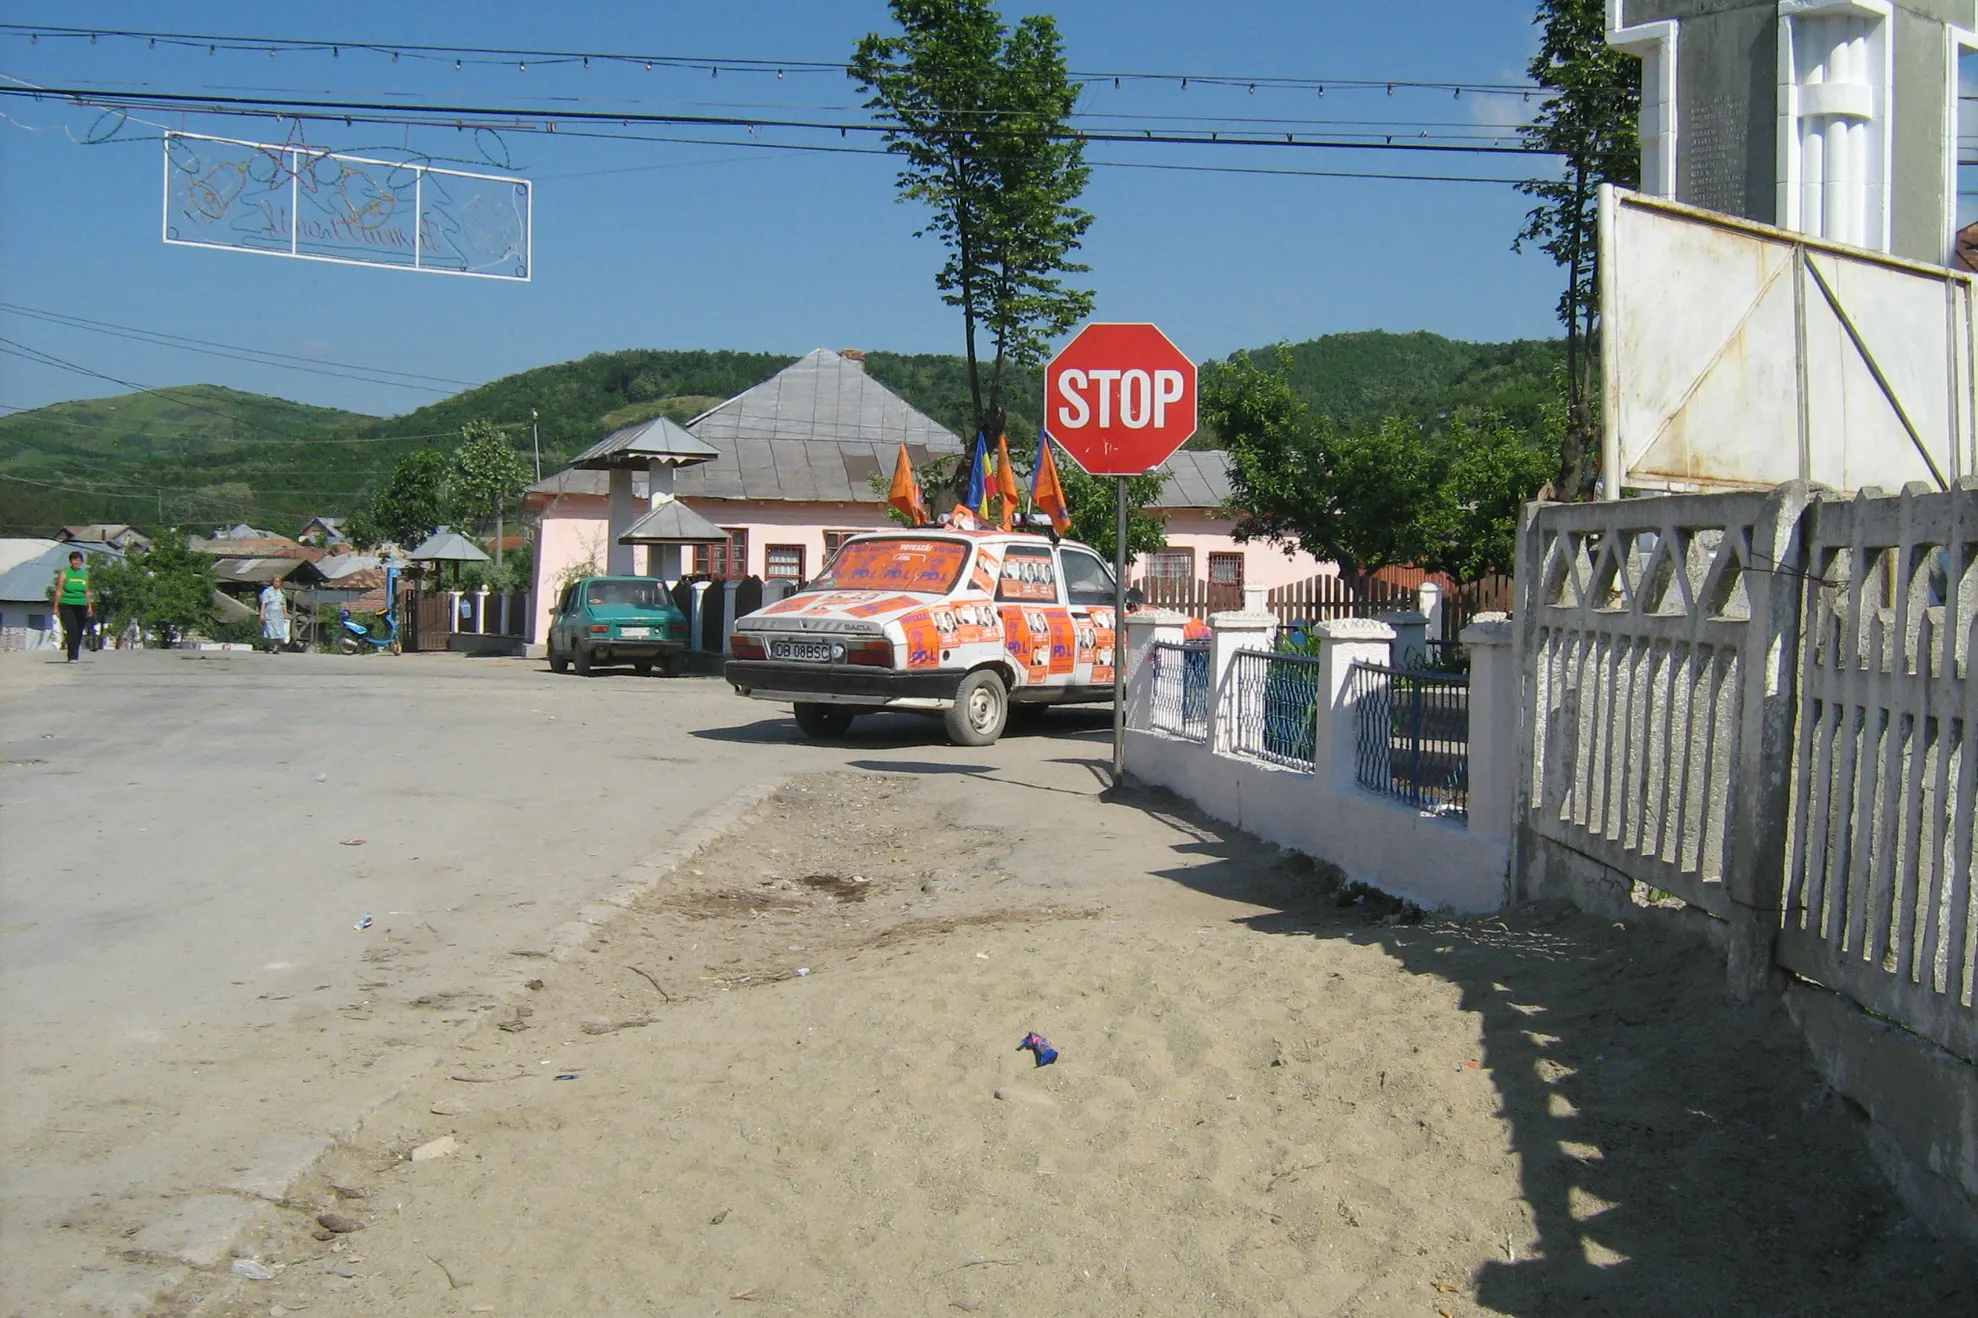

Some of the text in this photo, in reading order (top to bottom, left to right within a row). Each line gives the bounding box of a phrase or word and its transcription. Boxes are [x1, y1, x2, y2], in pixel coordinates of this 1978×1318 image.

[1057, 368, 1184, 429] STOP
[844, 624, 872, 632] DACIA
[776, 644, 791, 658] DB
